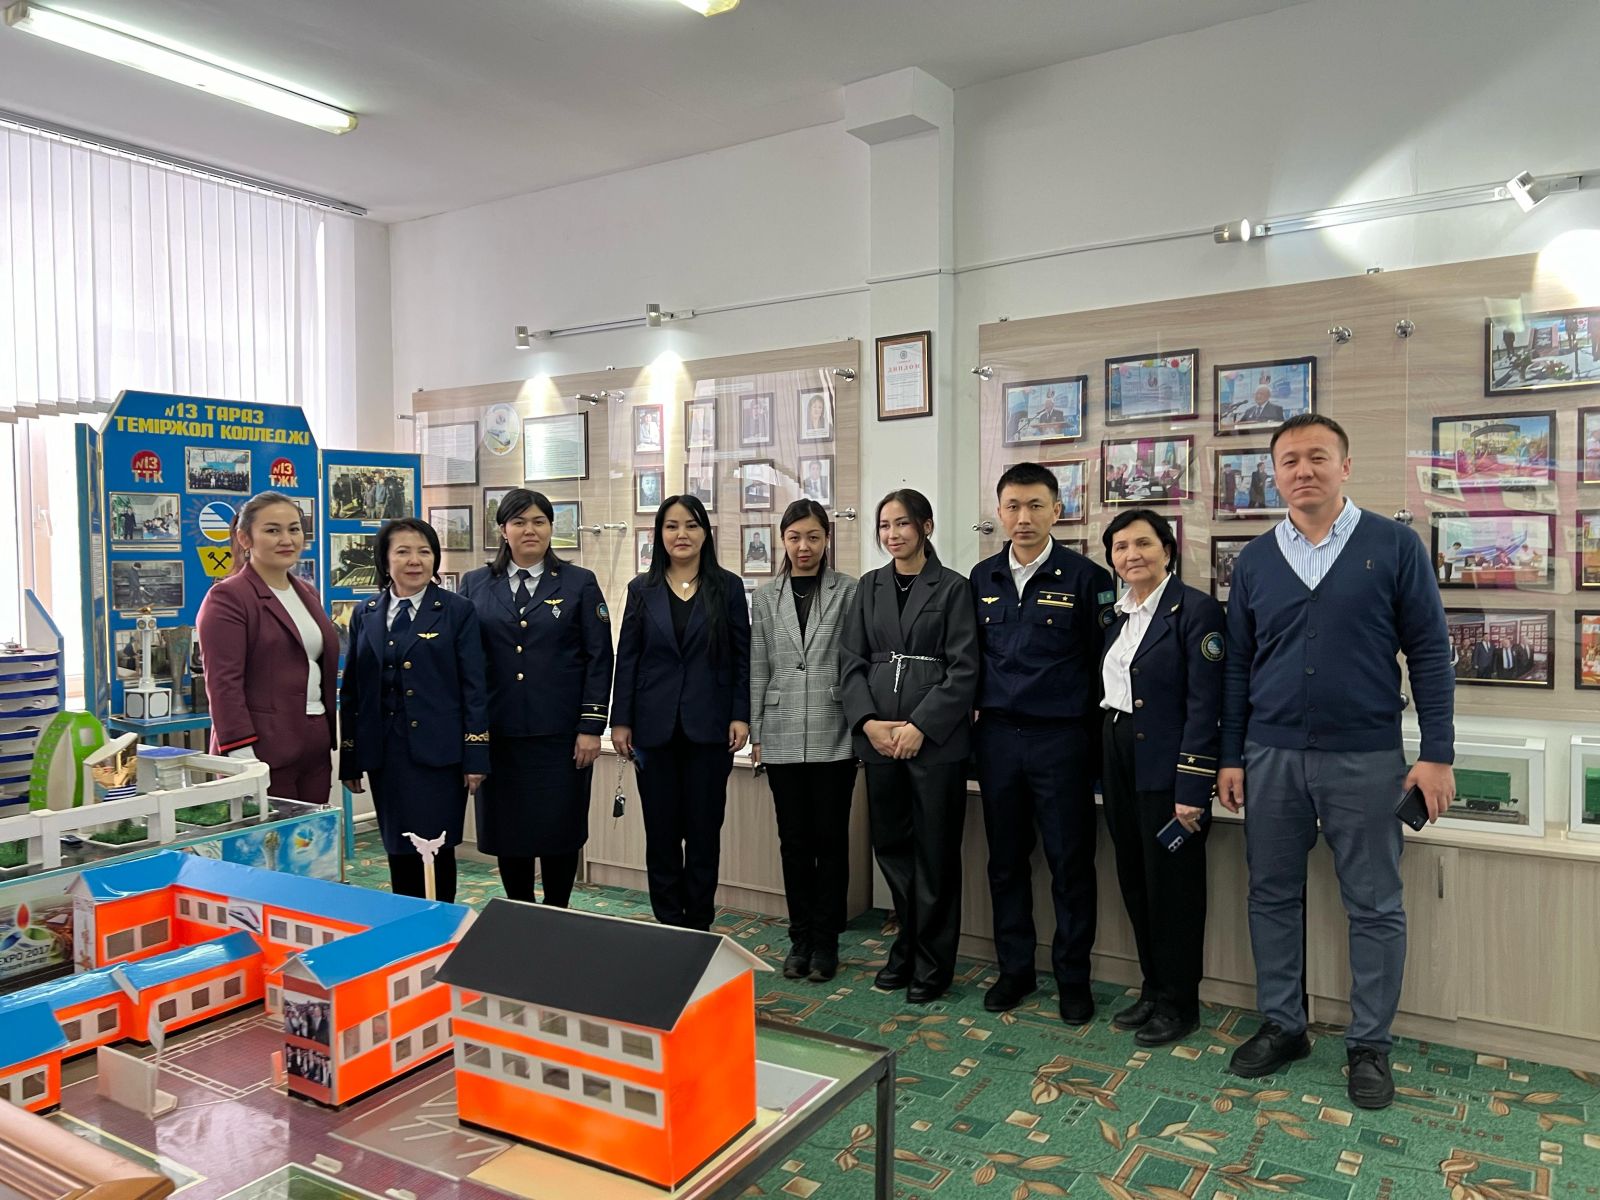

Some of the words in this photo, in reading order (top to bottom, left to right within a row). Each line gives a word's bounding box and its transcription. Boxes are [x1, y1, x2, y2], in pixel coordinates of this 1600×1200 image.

[204, 404, 264, 424] ТАРАЗ
[113, 415, 214, 439] ТЕМІРЖОЛ
[220, 424, 310, 446] КОЛЛЕДЖІ
[131, 470, 164, 483] ТТК
[268, 474, 299, 488] ТЖК
[25, 944, 50, 959] 2017
